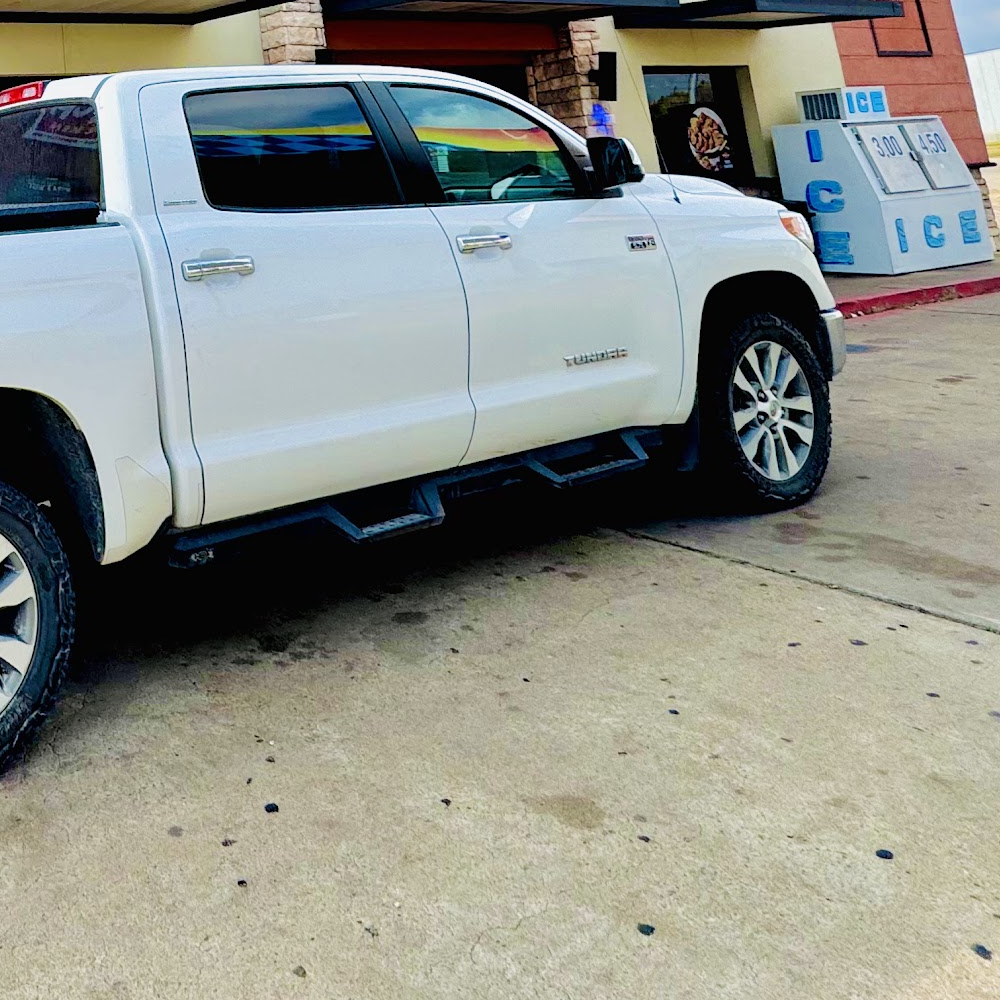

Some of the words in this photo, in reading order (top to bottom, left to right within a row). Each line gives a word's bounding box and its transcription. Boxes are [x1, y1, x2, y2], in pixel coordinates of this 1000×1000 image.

[846, 91, 885, 113] ICE
[872, 135, 903, 158] 3.00
[920, 133, 947, 155] 4.50
[805, 128, 854, 265] ICE
[895, 209, 981, 254] ICE
